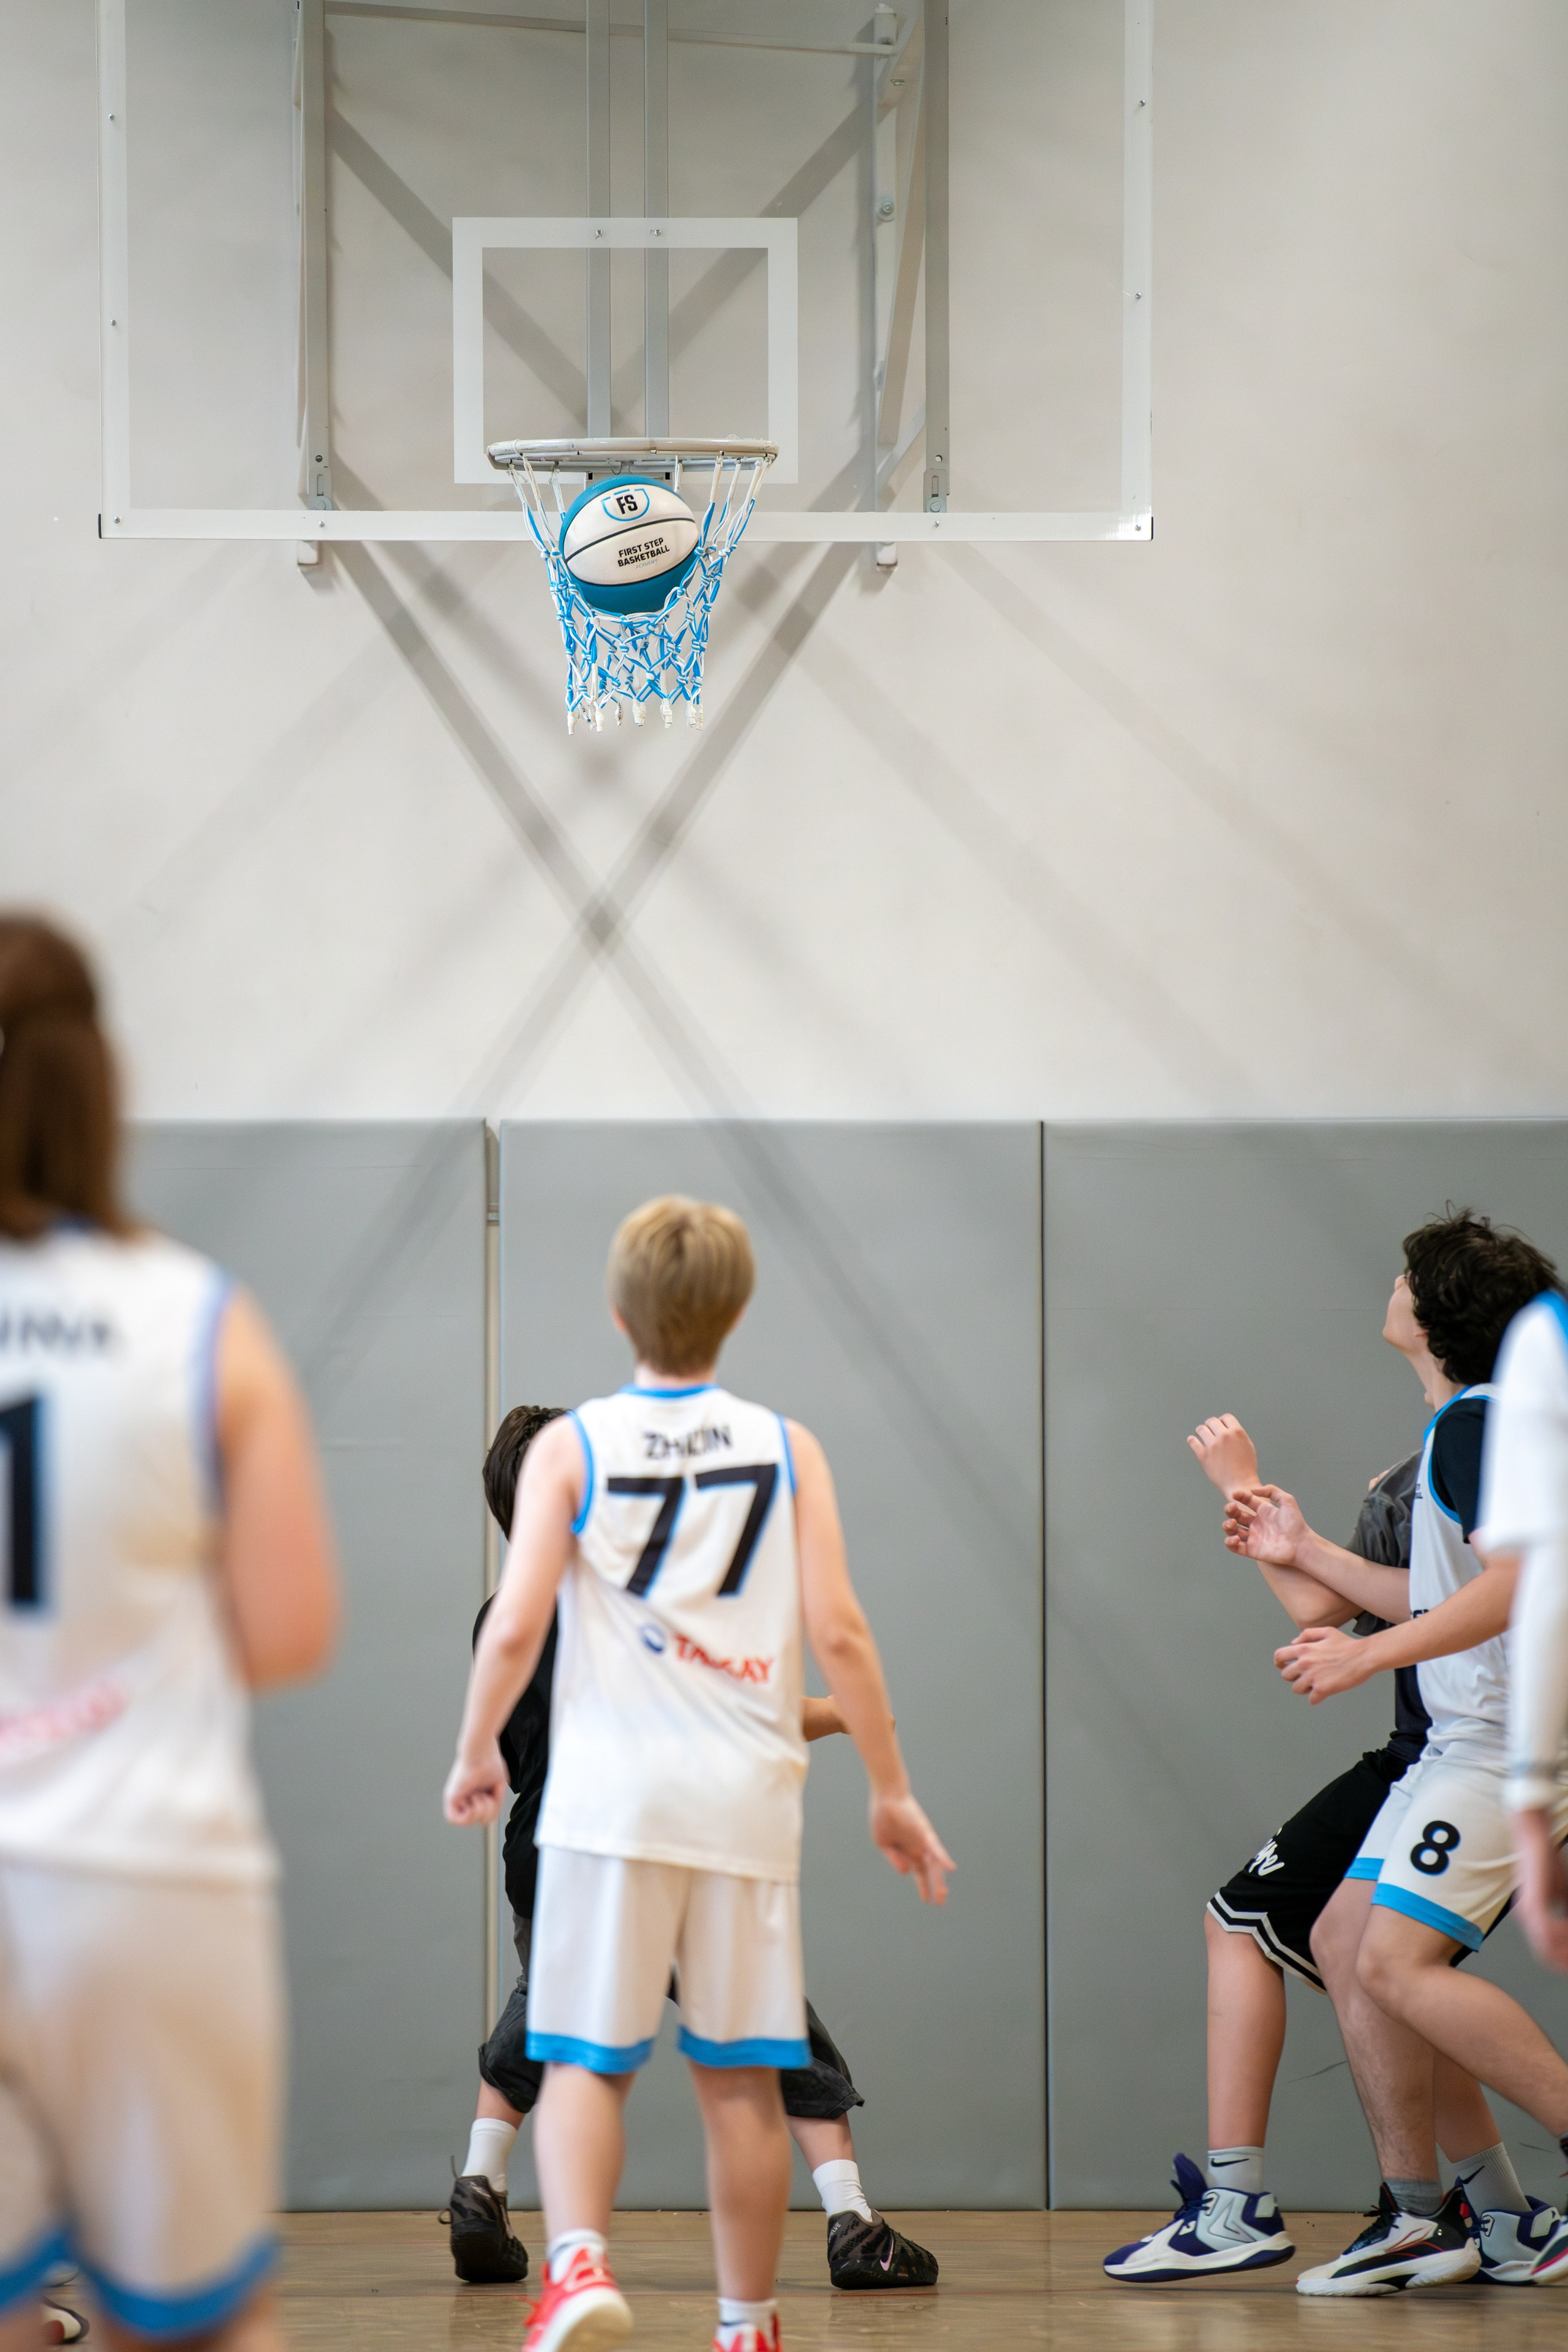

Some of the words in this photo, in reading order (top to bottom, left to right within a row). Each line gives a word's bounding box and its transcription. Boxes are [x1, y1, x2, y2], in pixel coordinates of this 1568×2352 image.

[616, 494, 638, 514] FS
[617, 545, 670, 567] BASKETBALL
[619, 545, 642, 557] FIRST
[644, 537, 664, 550] STEP
[607, 1463, 780, 1599] 77
[1410, 1820, 1461, 1876] 8
